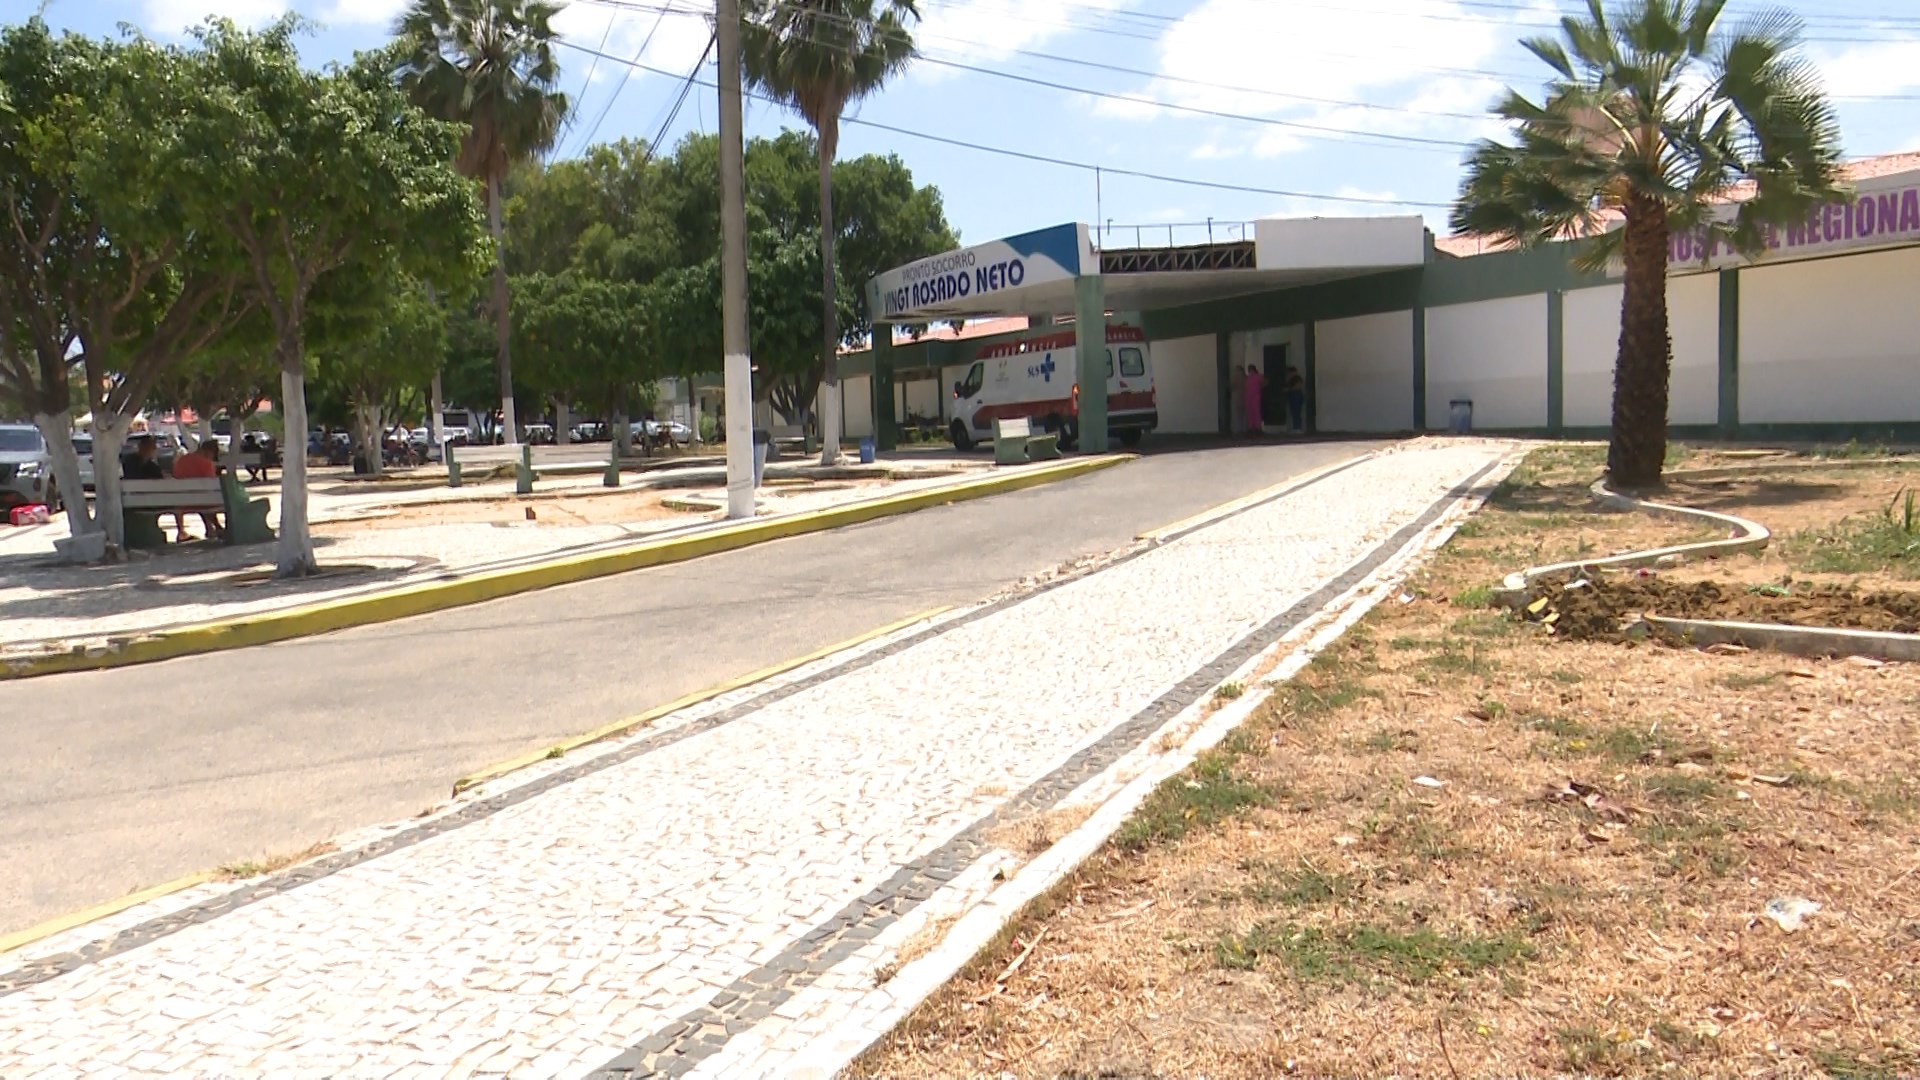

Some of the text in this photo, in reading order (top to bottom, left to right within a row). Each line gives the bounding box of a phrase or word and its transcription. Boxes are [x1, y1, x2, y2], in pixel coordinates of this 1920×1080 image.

[884, 259, 1024, 314] VINGT ROSADO NETO
[903, 251, 976, 282] PRONTO SOCORRO
